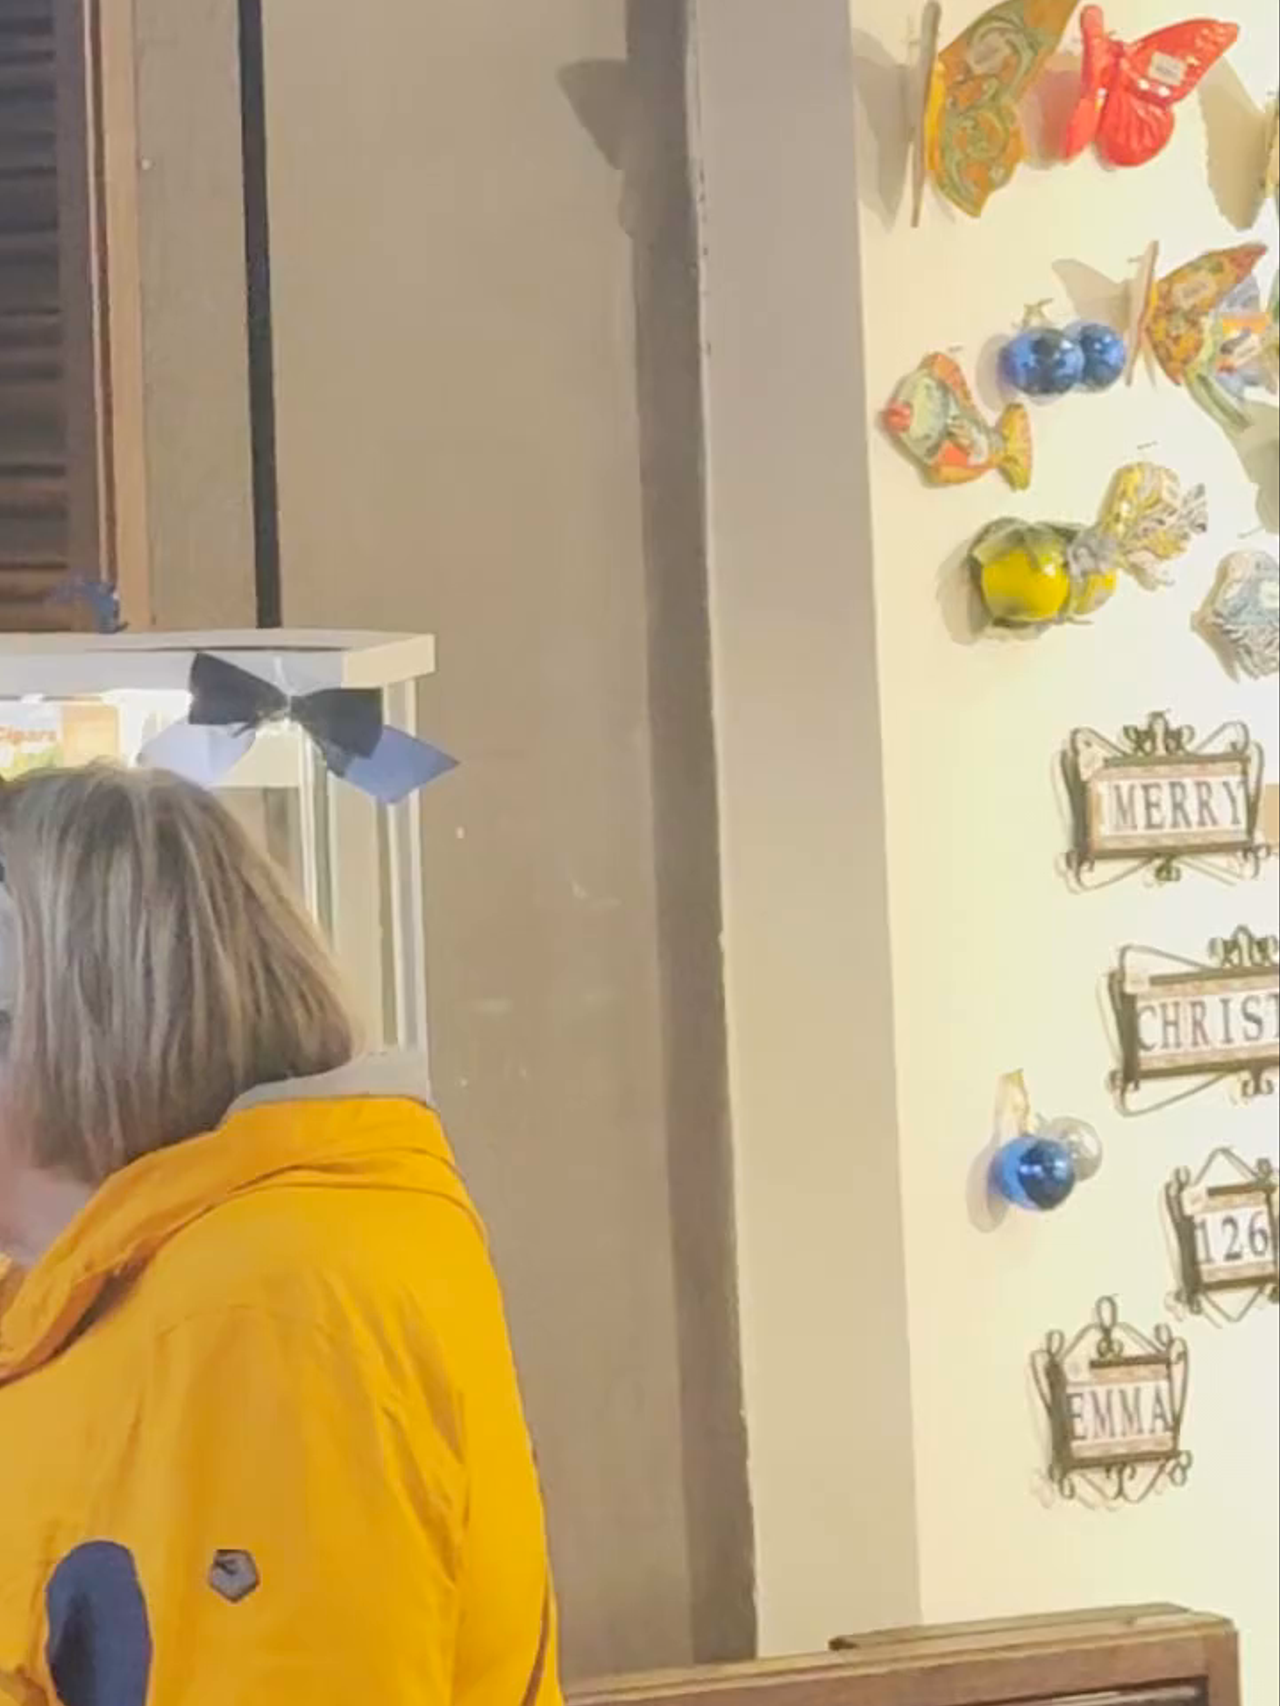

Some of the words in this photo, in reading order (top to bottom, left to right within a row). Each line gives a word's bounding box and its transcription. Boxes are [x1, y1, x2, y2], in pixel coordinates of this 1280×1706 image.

[1113, 779, 1248, 831] MERRY
[1195, 1210, 1269, 1263] 126
[1066, 1385, 1175, 1440] EMMA
